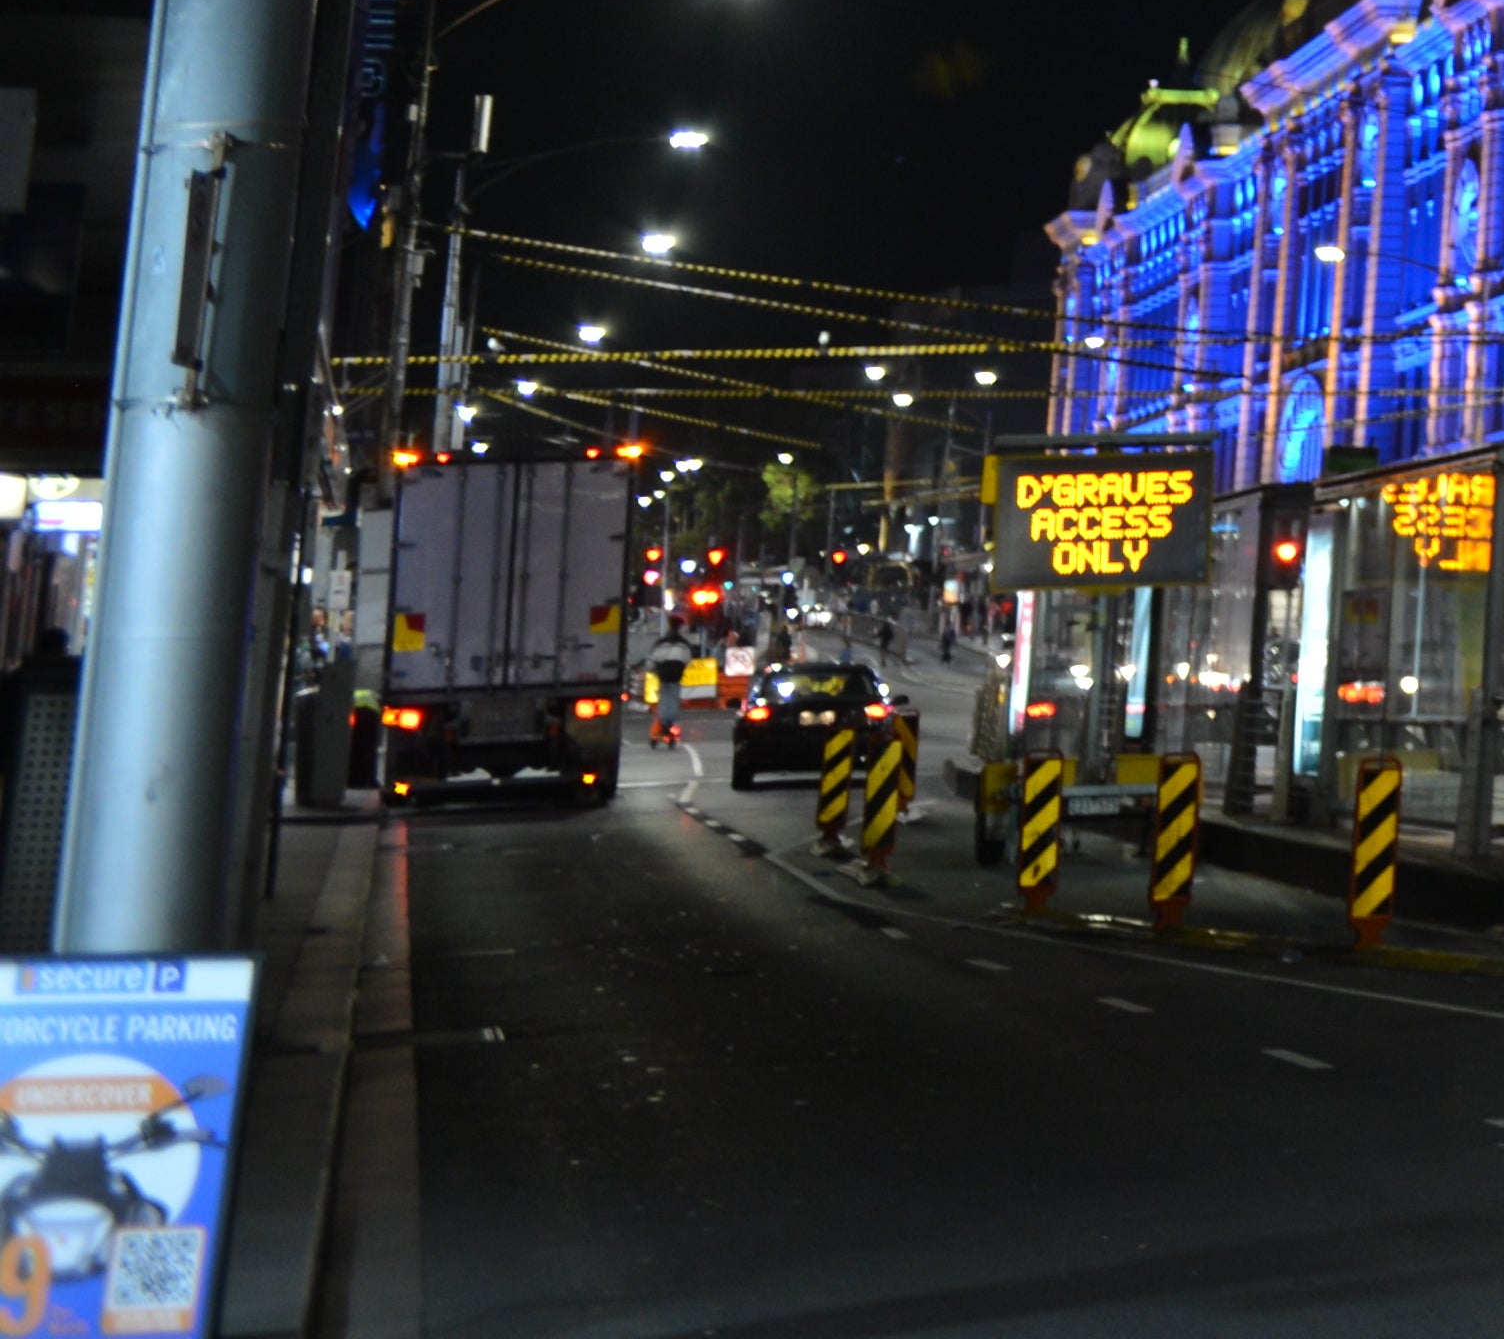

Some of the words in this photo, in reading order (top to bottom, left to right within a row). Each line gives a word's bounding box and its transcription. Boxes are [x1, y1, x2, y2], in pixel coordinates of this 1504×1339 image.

[1017, 470, 1194, 509] D'GRAVES
[1031, 505, 1173, 542] ACCESS
[1053, 538, 1148, 575] ONLY
[126, 1013, 238, 1042] PARKING
